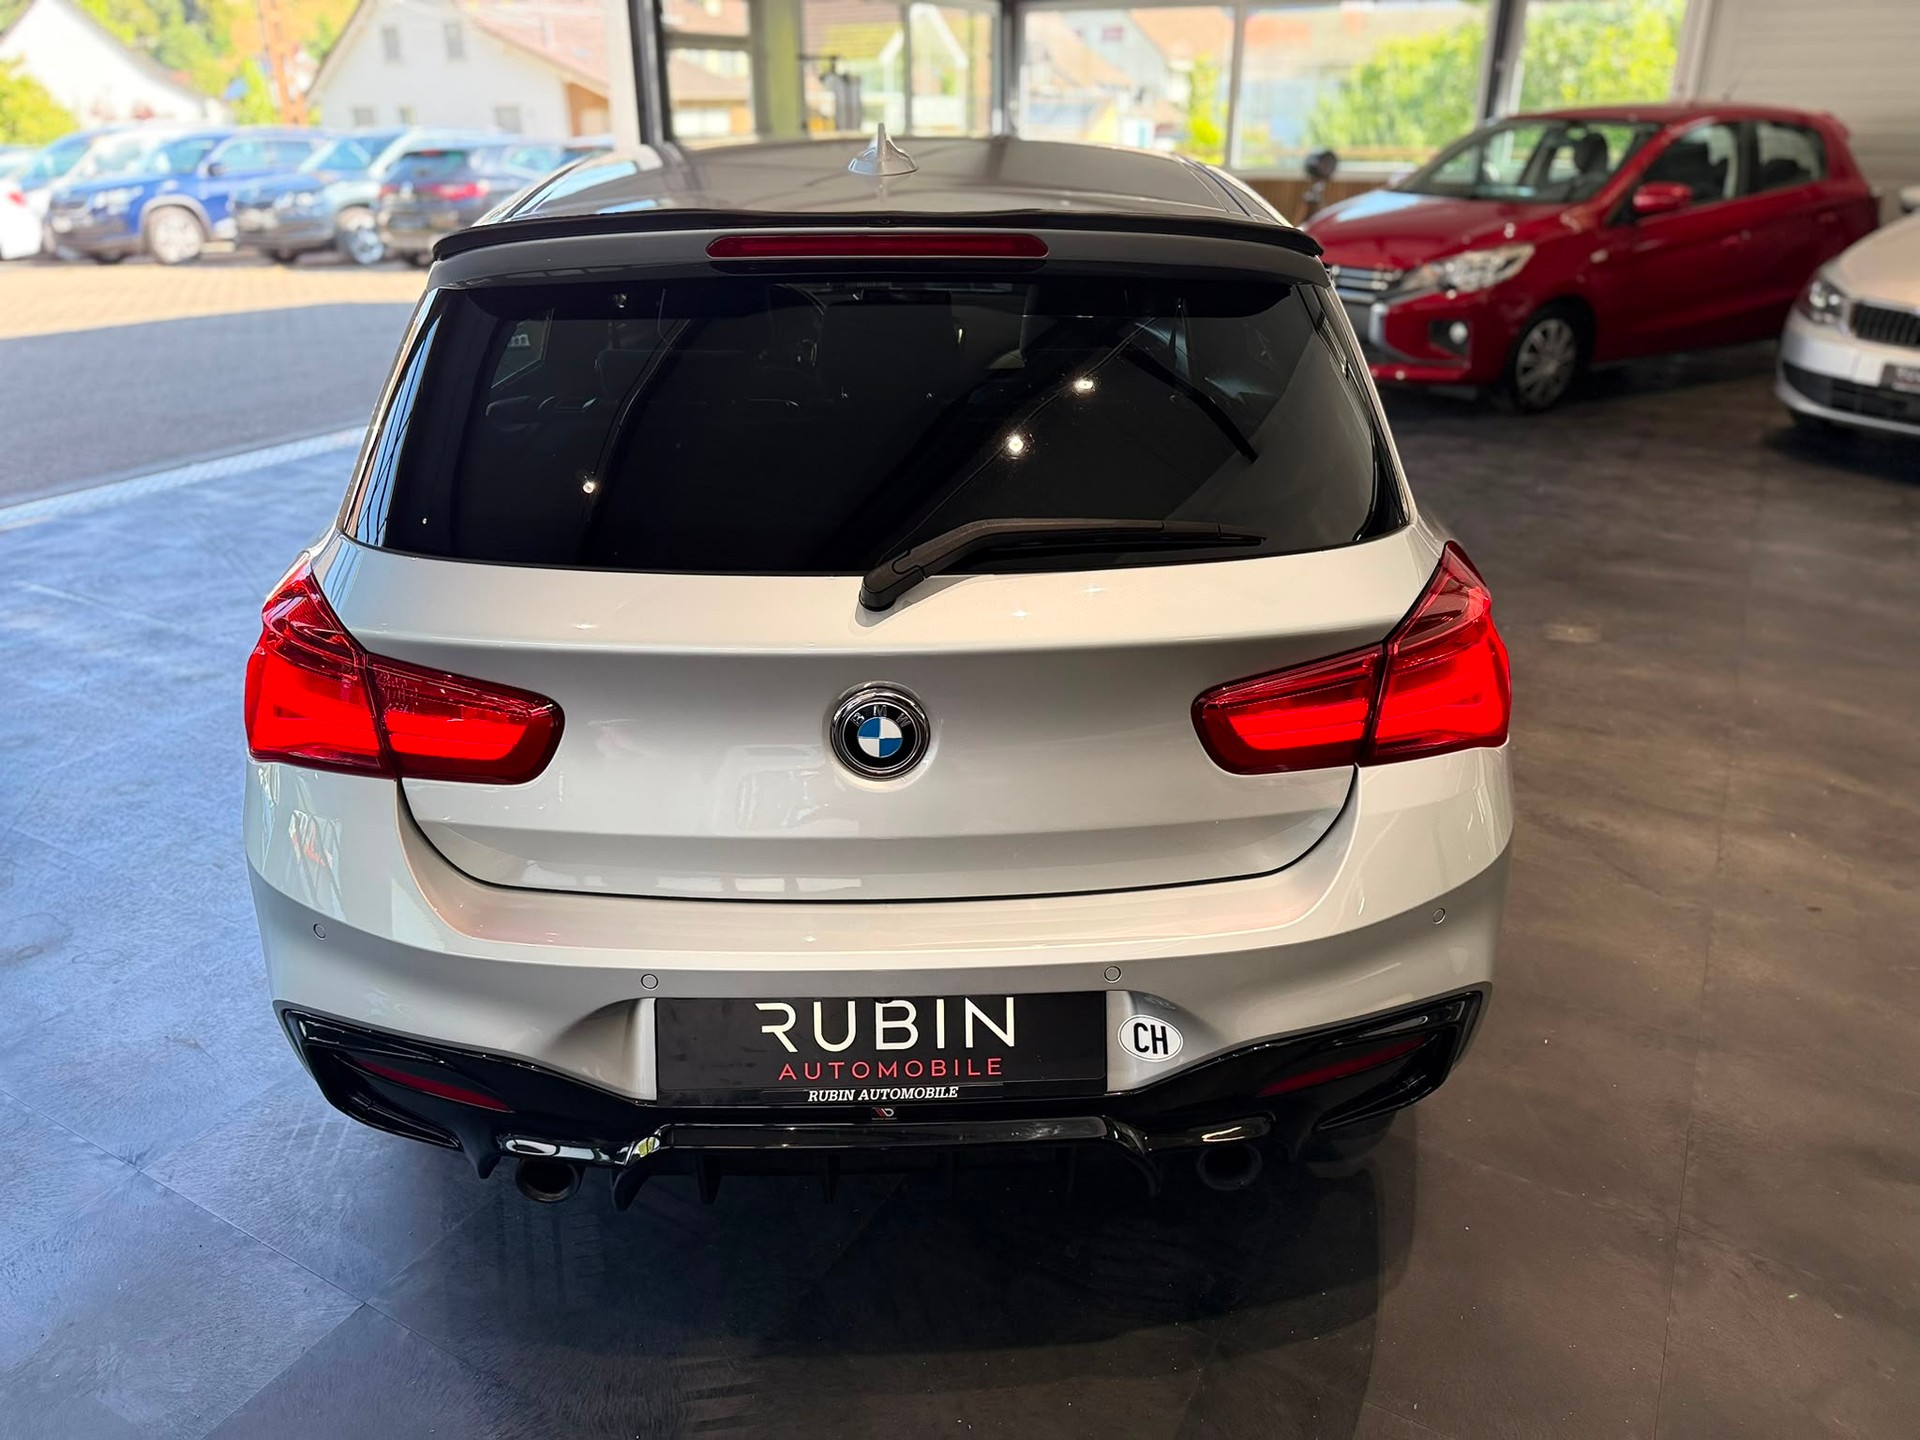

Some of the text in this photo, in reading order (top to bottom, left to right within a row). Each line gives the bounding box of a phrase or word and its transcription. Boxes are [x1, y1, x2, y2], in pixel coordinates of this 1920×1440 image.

[850, 704, 911, 728] BMW
[755, 997, 1014, 1053] RUBIN
[1133, 1022, 1169, 1055] CH
[778, 1057, 1002, 1081] AUTOMOBILE
[808, 1086, 959, 1102] RUBIN AUTOMOBILE
